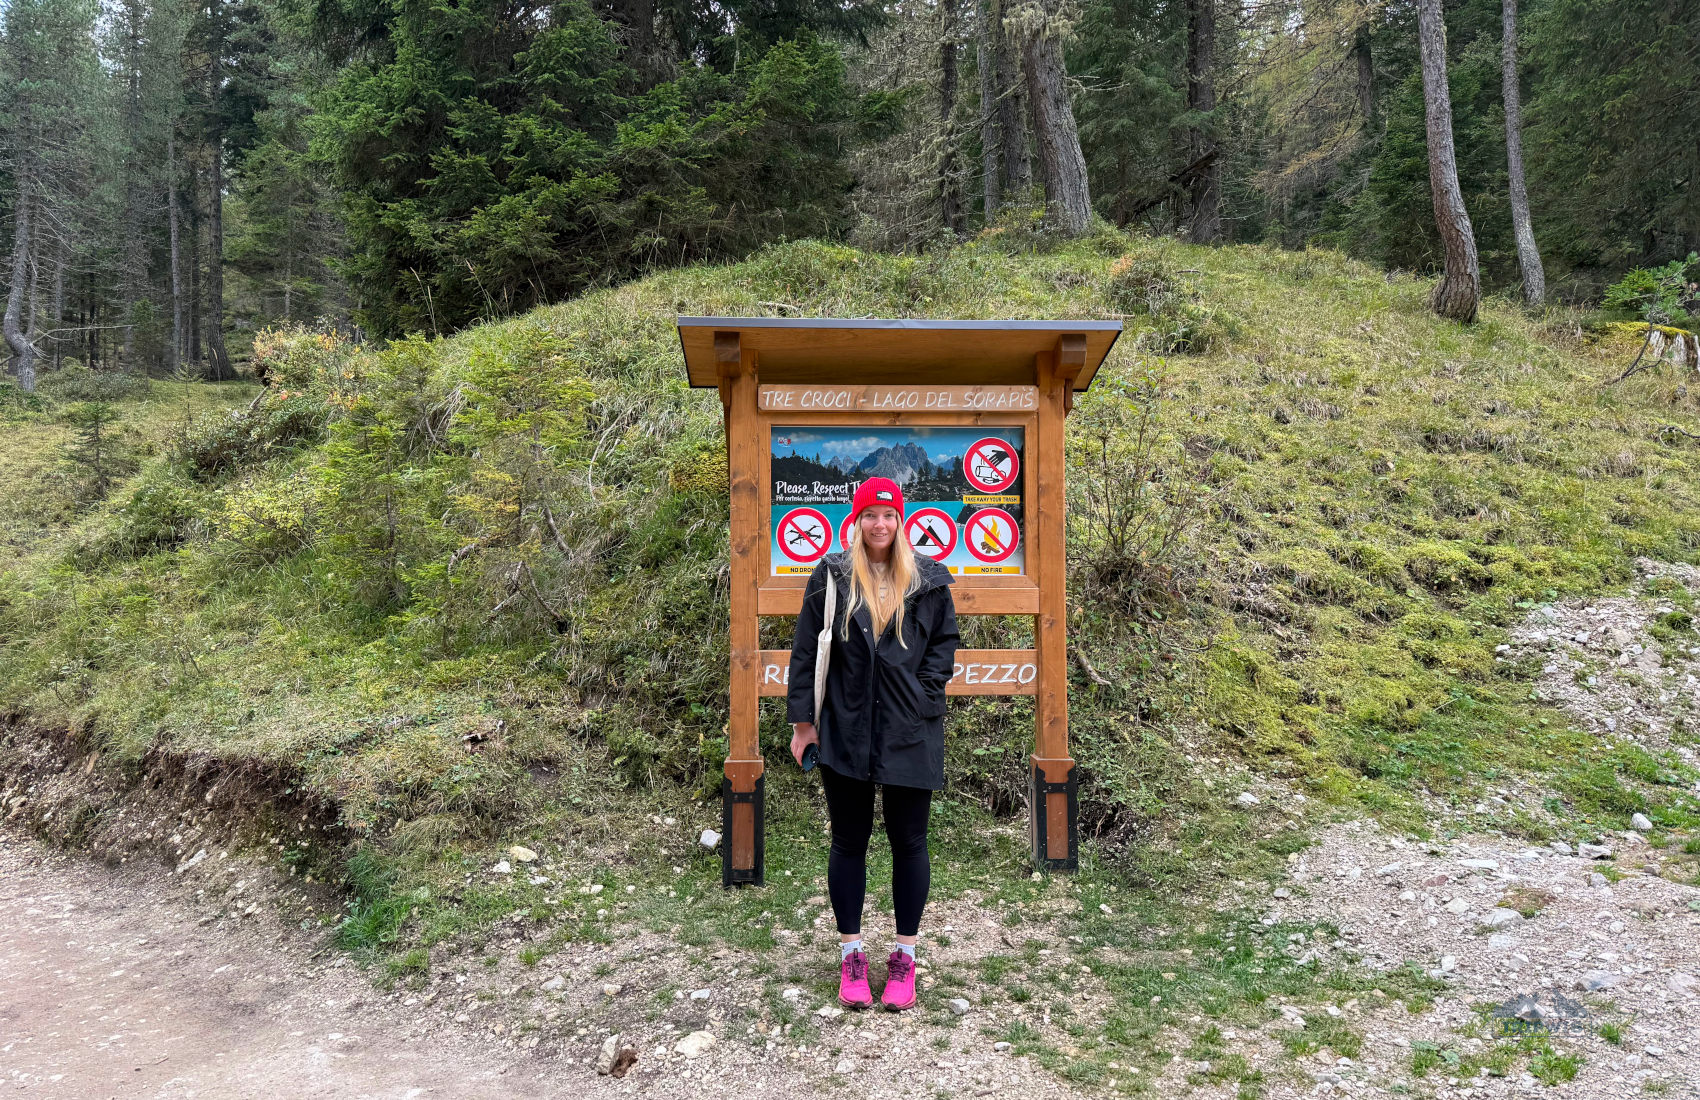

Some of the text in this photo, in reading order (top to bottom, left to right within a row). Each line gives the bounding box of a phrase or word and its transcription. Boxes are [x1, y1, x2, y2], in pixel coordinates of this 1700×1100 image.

[763, 391, 793, 407] TRE
[801, 390, 851, 408] CROCI
[873, 391, 918, 408] LAGO
[926, 391, 957, 408] DEL
[775, 480, 861, 495] Please, Respect T
